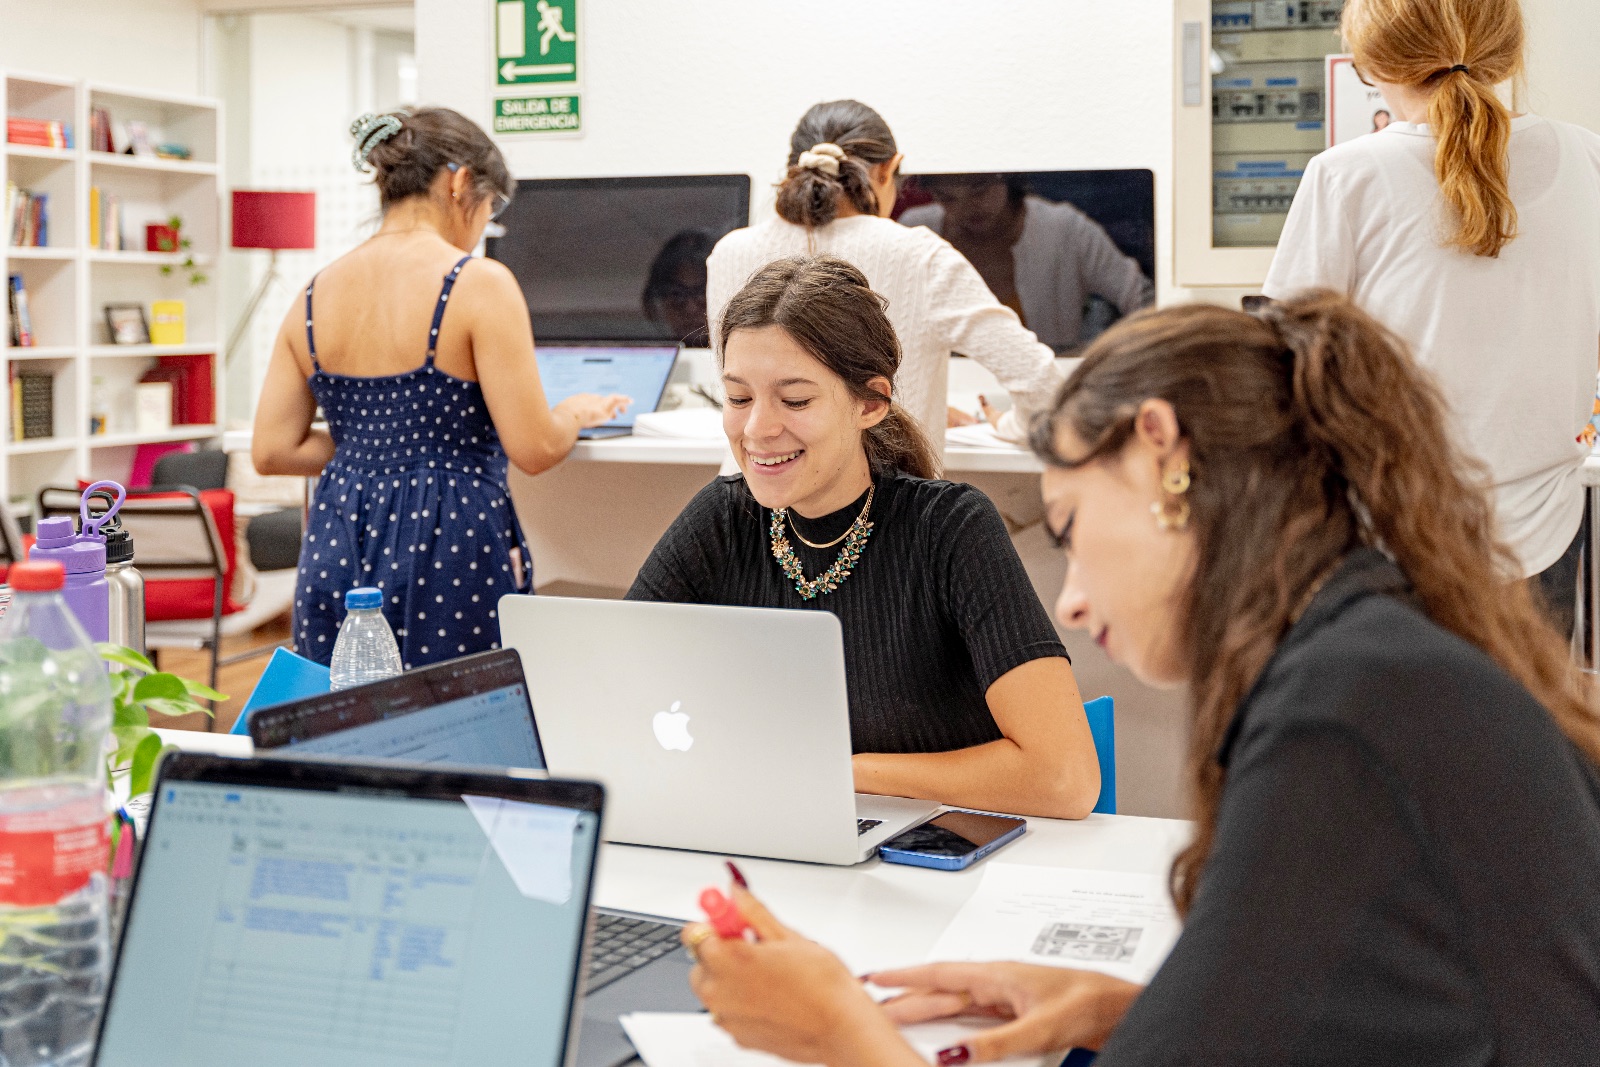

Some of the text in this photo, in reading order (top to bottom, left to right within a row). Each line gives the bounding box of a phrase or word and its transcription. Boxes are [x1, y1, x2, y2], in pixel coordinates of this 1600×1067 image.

[502, 98, 570, 115] SALIDA DE
[496, 114, 578, 131] EMERGENCIA
